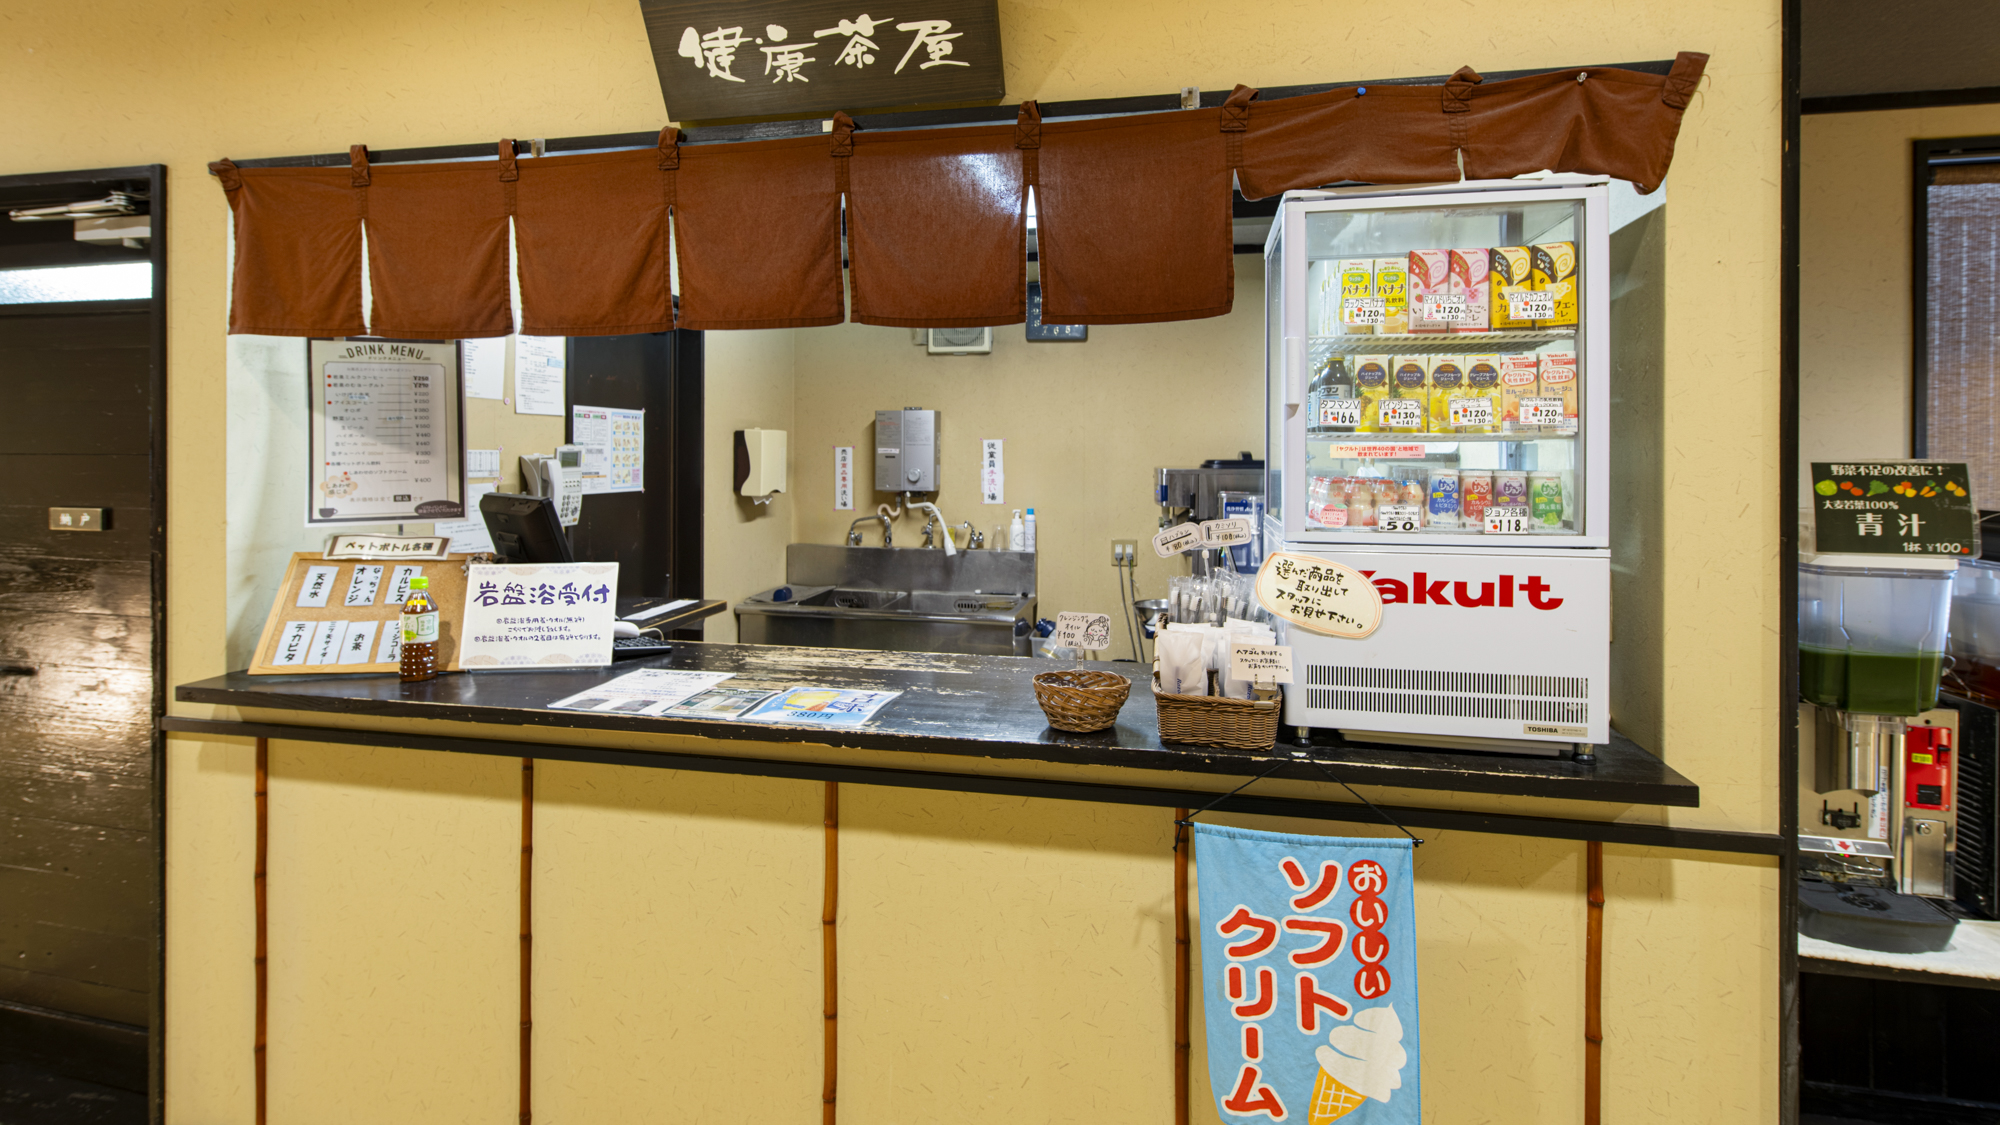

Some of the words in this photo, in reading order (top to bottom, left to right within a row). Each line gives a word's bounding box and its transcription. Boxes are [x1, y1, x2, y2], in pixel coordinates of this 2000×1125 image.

[678, 14, 970, 83] 健康茶屋
[1342, 284, 1370, 295] バナナ
[1378, 284, 1406, 295] バナナ
[1510, 293, 1552, 302] マイルドカフェオレ
[346, 344, 385, 358] DRINK
[390, 345, 424, 360] MENU
[1321, 400, 1360, 408] タフマンV
[1380, 400, 1420, 409] パインジュース
[988, 442, 997, 500] 従業員手洗い場
[1830, 465, 1943, 476] 野菜不足の改善に！
[1485, 508, 1527, 516] ジョア各種
[1823, 500, 1899, 510] 大麦若葉100%
[1856, 513, 1926, 537] 青汁
[345, 542, 434, 551] ペットボトル各種
[1926, 542, 1962, 553] ¥100
[1275, 559, 1344, 585] 選んだ商品を
[309, 573, 326, 598] 天然水
[348, 567, 367, 603] オレンジ
[364, 567, 381, 603] なっちゃん
[473, 581, 610, 607] 岩盤浴受付
[1295, 579, 1348, 597] 取り出して
[1357, 570, 1564, 610] akult
[1276, 588, 1321, 606] スタッフに
[1291, 604, 1363, 629] お見せ下さい。
[351, 633, 365, 651] お茶
[1058, 630, 1075, 639] ¥100
[787, 711, 834, 720] 380円
[1353, 863, 1386, 997] おいしい
[1281, 859, 1350, 1033] ソフト
[1219, 907, 1285, 1118] クリーム
